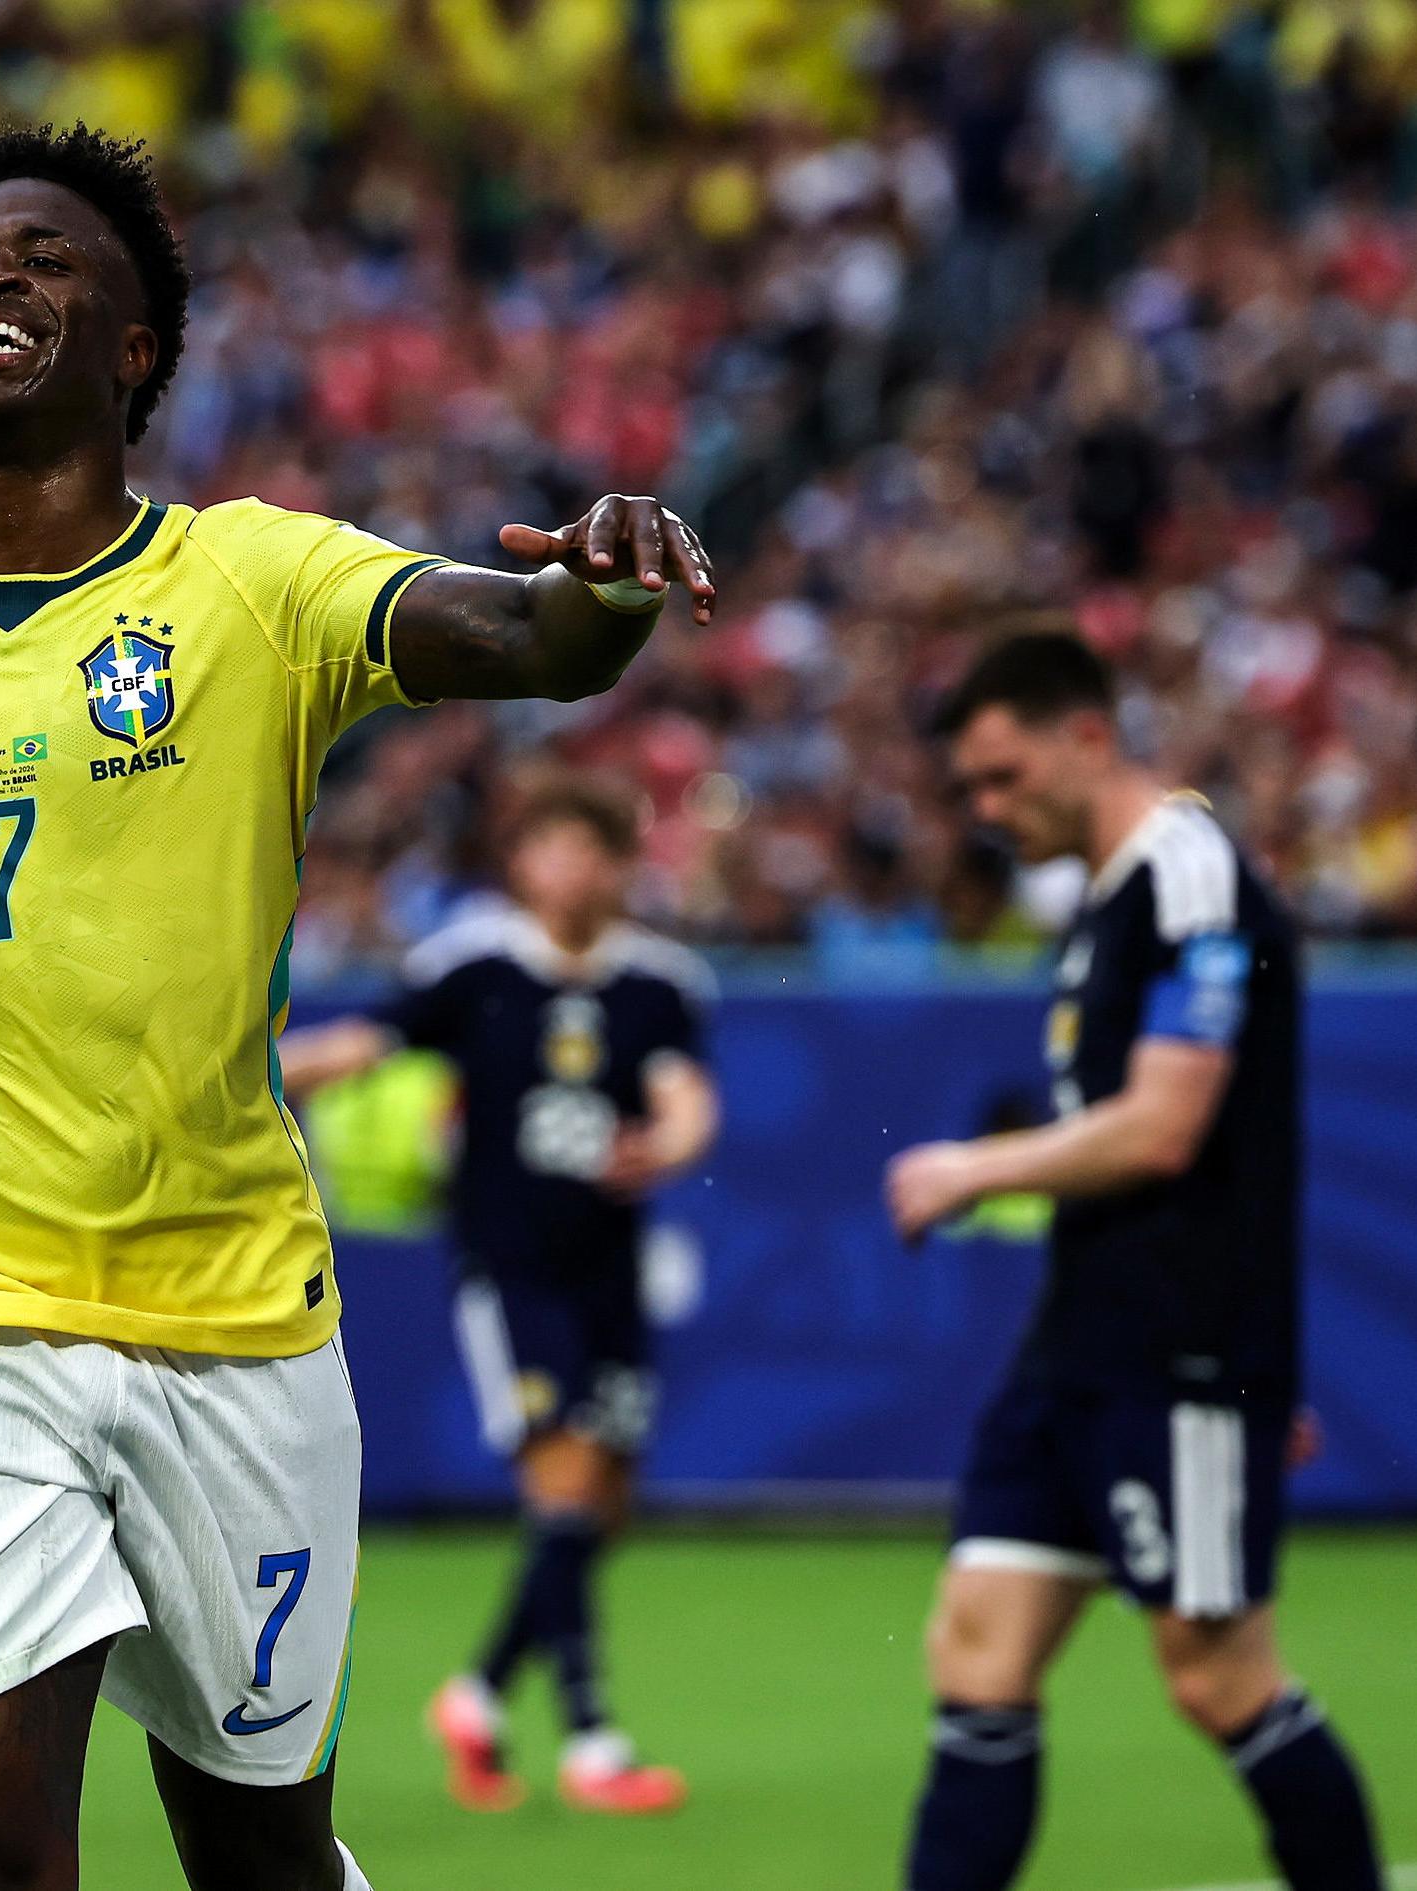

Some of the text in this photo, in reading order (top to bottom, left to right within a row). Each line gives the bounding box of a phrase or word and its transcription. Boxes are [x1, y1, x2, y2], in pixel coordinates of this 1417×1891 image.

[111, 675, 146, 693] CBF
[18, 765, 35, 773] 2026
[89, 744, 186, 782] BRASIL
[12, 774, 37, 784] BRASIL
[10, 786, 24, 794] EUA
[251, 1547, 311, 1687] 7
